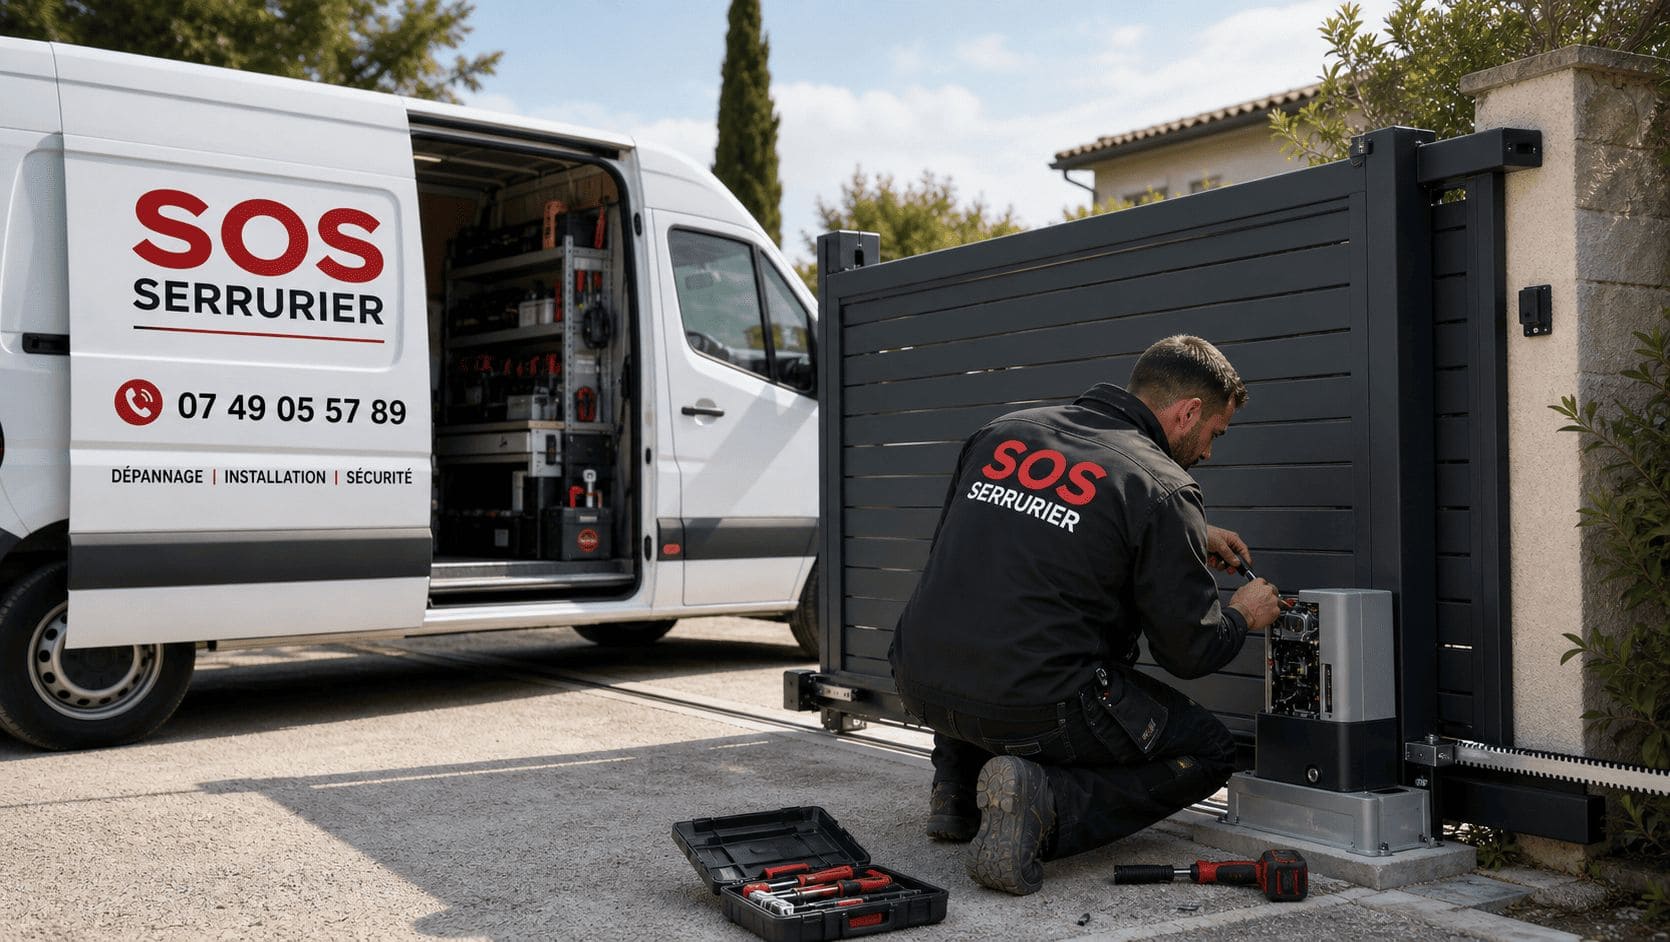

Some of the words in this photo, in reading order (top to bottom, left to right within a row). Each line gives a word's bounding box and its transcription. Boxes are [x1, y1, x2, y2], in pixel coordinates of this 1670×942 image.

[132, 188, 384, 283] SOS
[133, 277, 384, 325] SERRURIER
[178, 391, 217, 419] 07
[227, 394, 266, 421] 49
[277, 396, 315, 423] 05
[325, 397, 361, 424] 57
[371, 399, 407, 425] 89
[111, 465, 204, 484] DÉPANNAGE
[224, 469, 327, 485] INSTALLATION
[346, 467, 413, 485] SÉCURITÉ
[981, 439, 1108, 506] SOS
[966, 481, 1081, 533] SERRURIER
